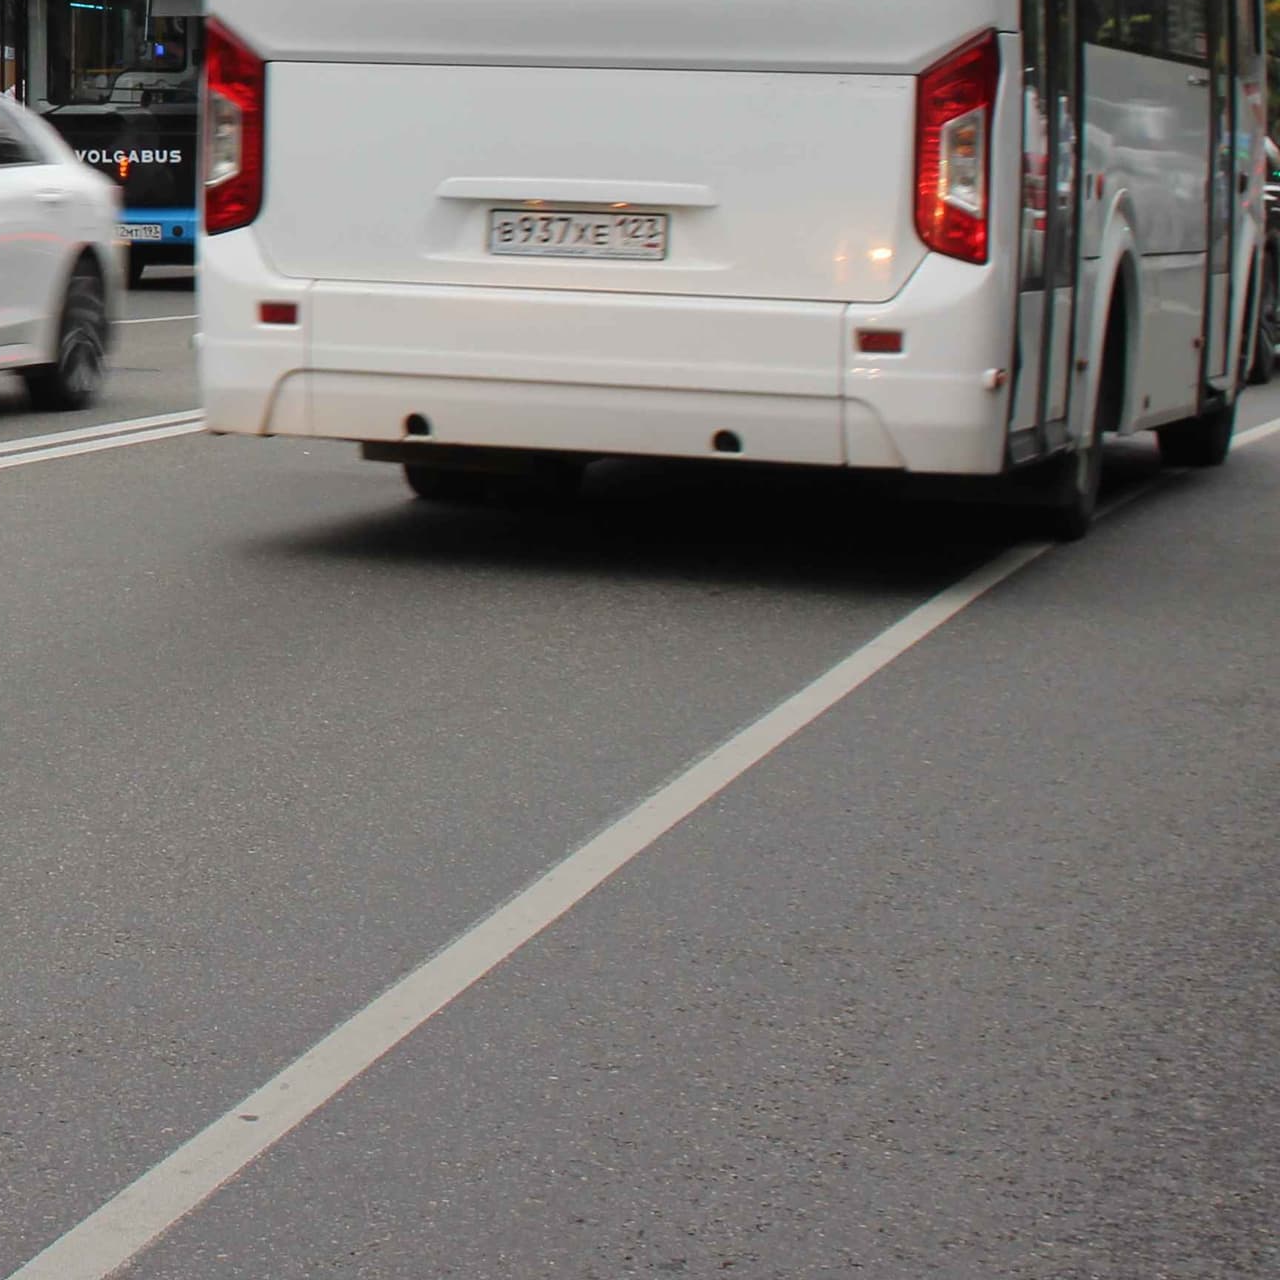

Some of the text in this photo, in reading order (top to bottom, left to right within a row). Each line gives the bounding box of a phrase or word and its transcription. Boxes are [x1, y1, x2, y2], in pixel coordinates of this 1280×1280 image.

[75, 149, 183, 164] VOLGABUS
[116, 223, 160, 238] 2МТ 193
[615, 216, 659, 239] 123
